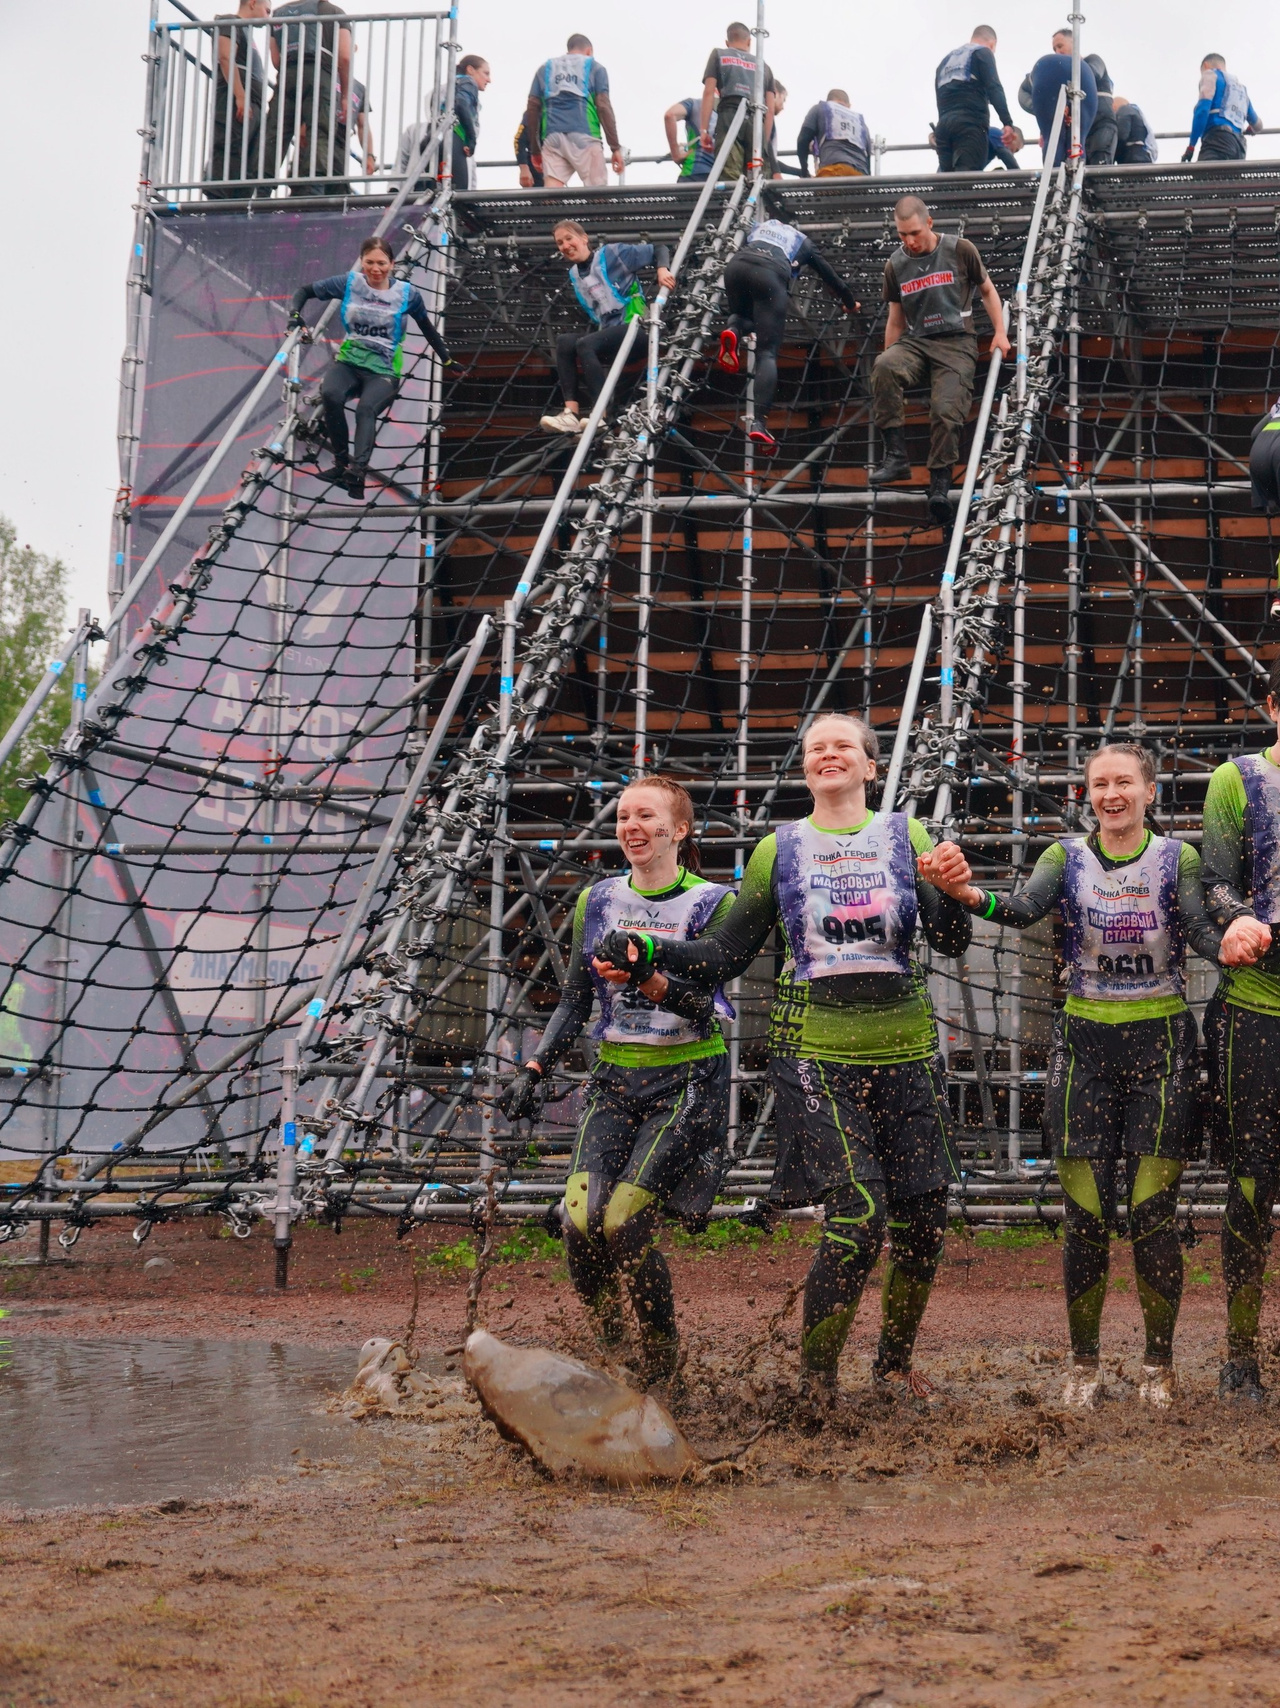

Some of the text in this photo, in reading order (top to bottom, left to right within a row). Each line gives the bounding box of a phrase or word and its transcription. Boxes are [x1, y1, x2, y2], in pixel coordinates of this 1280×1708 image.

[813, 850, 878, 862] ГОНКА ГЕРОЕВ
[813, 871, 883, 890] МАССОВЫЙ
[832, 891, 868, 905] СТАРТ
[1093, 884, 1150, 898] ГОНКА ГЕРОЕВ
[1094, 897, 1141, 913] АННА
[618, 918, 647, 929] ГОНКА
[1089, 911, 1155, 929] МАССОВЫЙ
[1105, 930, 1142, 943] СТАРТ
